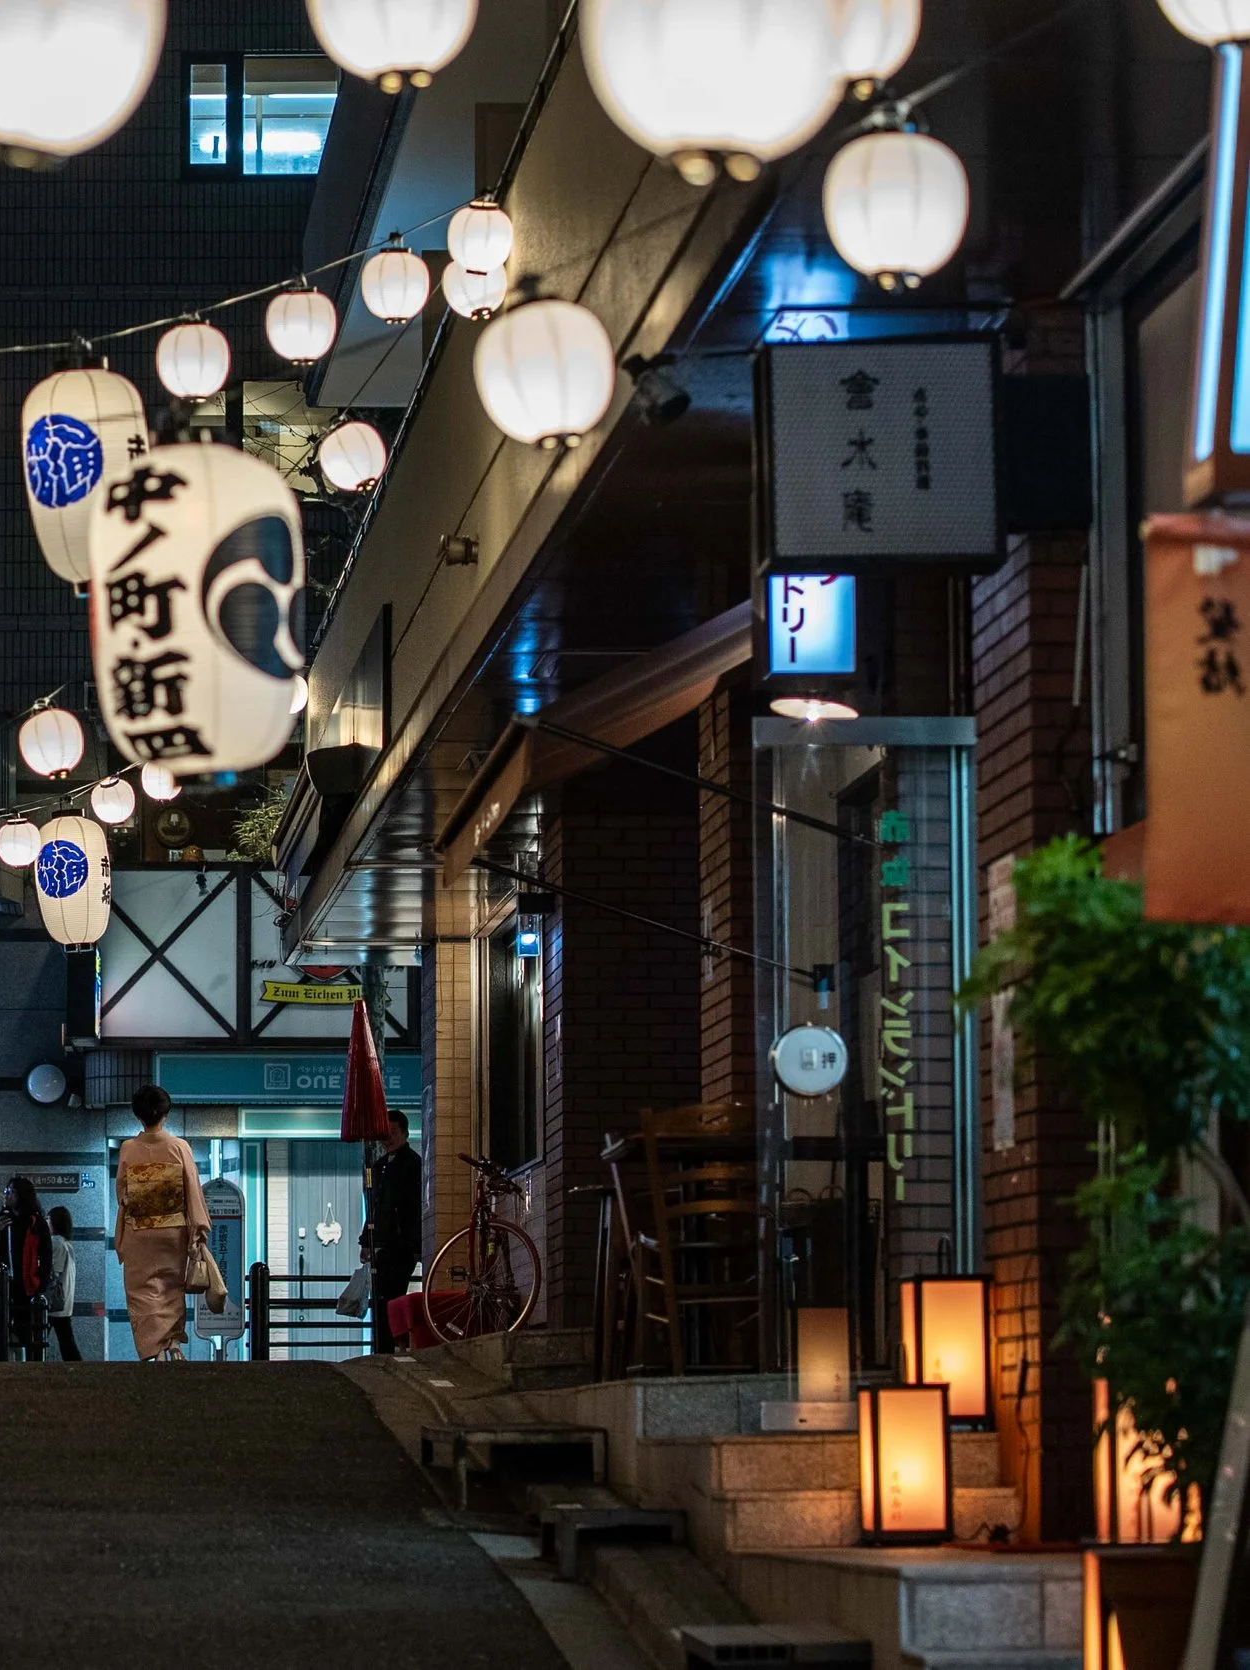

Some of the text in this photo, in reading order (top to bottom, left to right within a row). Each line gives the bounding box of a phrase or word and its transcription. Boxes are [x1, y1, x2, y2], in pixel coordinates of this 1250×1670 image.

[272, 986, 299, 999] Zum
[303, 988, 343, 1001] Eichen
[297, 1075, 341, 1089] ONE
